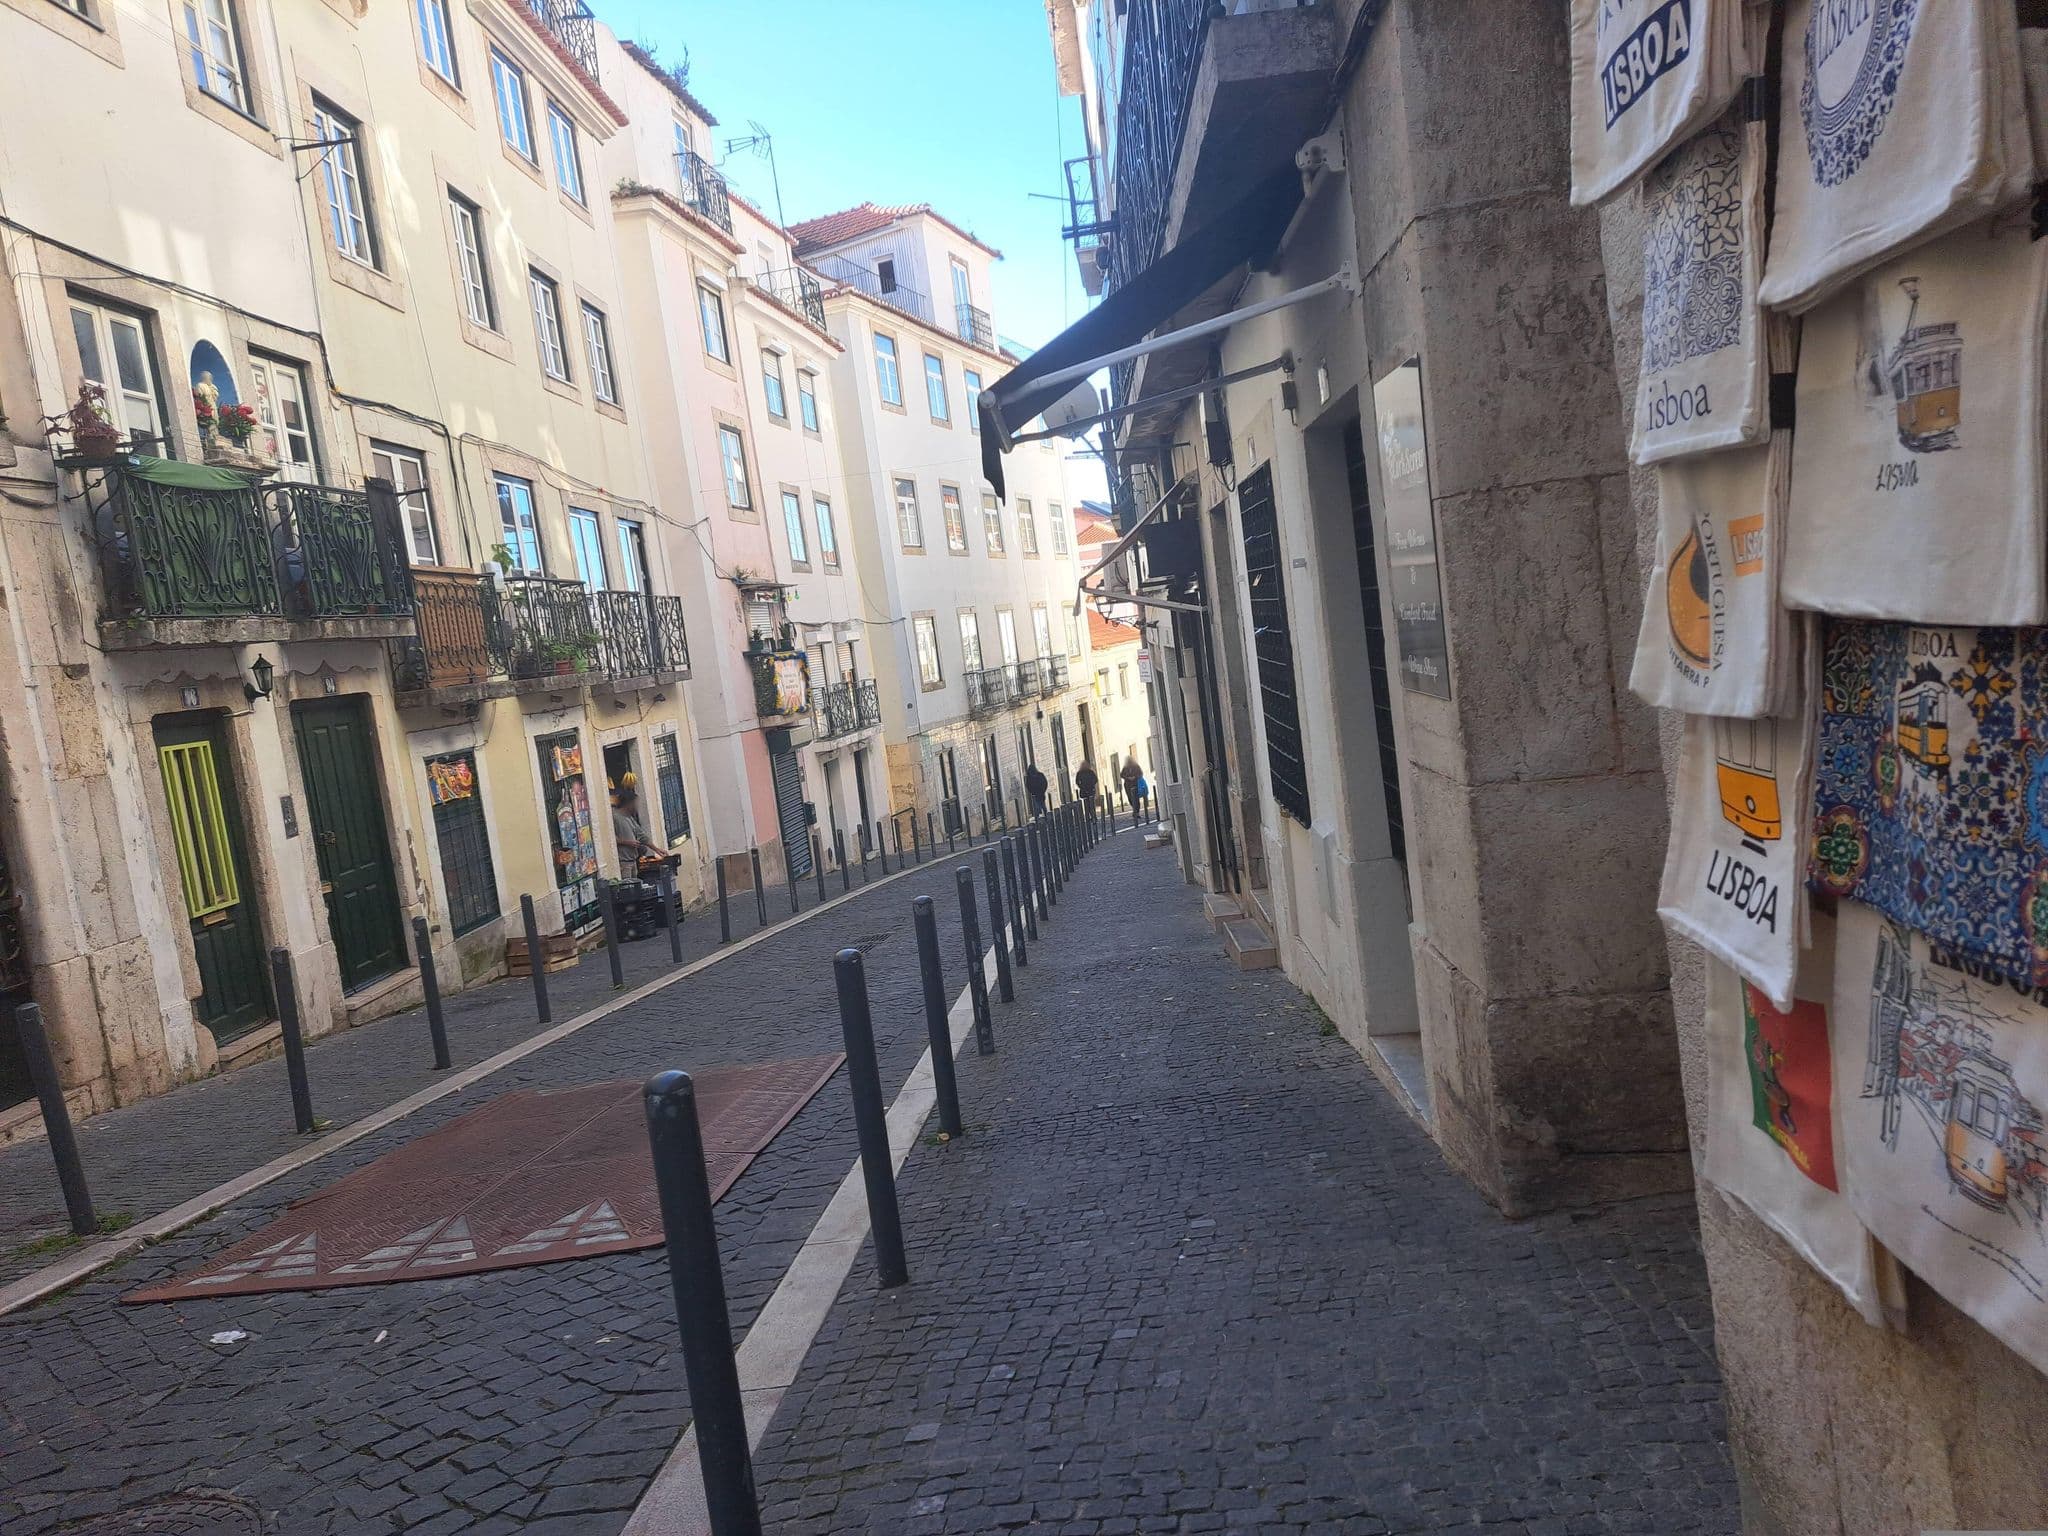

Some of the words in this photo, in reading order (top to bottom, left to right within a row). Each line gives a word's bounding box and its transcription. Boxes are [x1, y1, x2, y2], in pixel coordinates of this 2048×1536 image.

[1604, 2, 1689, 124] LISBOA
[1645, 379, 1712, 432] isboa
[1707, 849, 1778, 934] LISBOA
